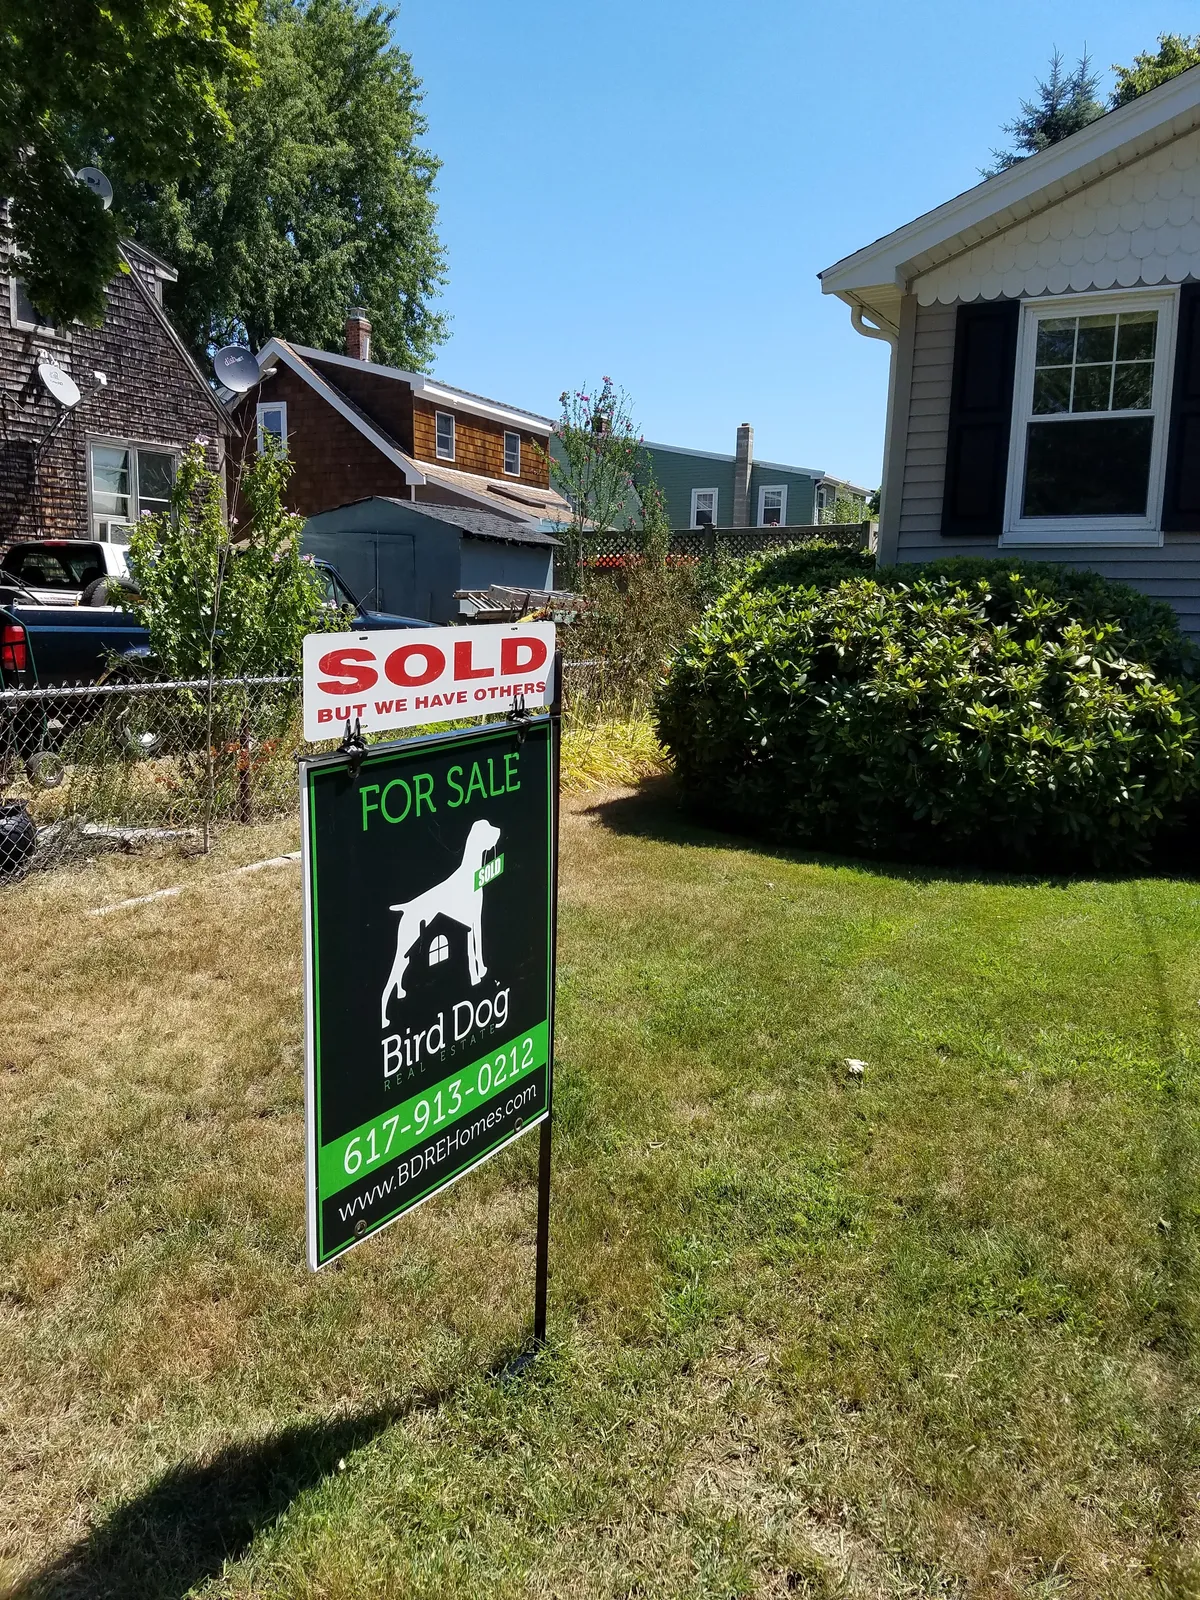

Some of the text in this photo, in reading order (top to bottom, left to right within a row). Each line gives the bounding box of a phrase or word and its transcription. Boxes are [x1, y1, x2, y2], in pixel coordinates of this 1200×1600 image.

[317, 636, 548, 695] SOLD
[317, 681, 546, 723] BUT WE HAVE OTHERS
[359, 752, 521, 831] FOR SALE
[478, 857, 502, 887] SOLD
[381, 987, 510, 1078] Bird Dog
[384, 1023, 495, 1092] REAL ESTATE
[343, 1037, 534, 1175] 617-913-0212
[338, 1084, 537, 1222] www.BDREHomes.com
